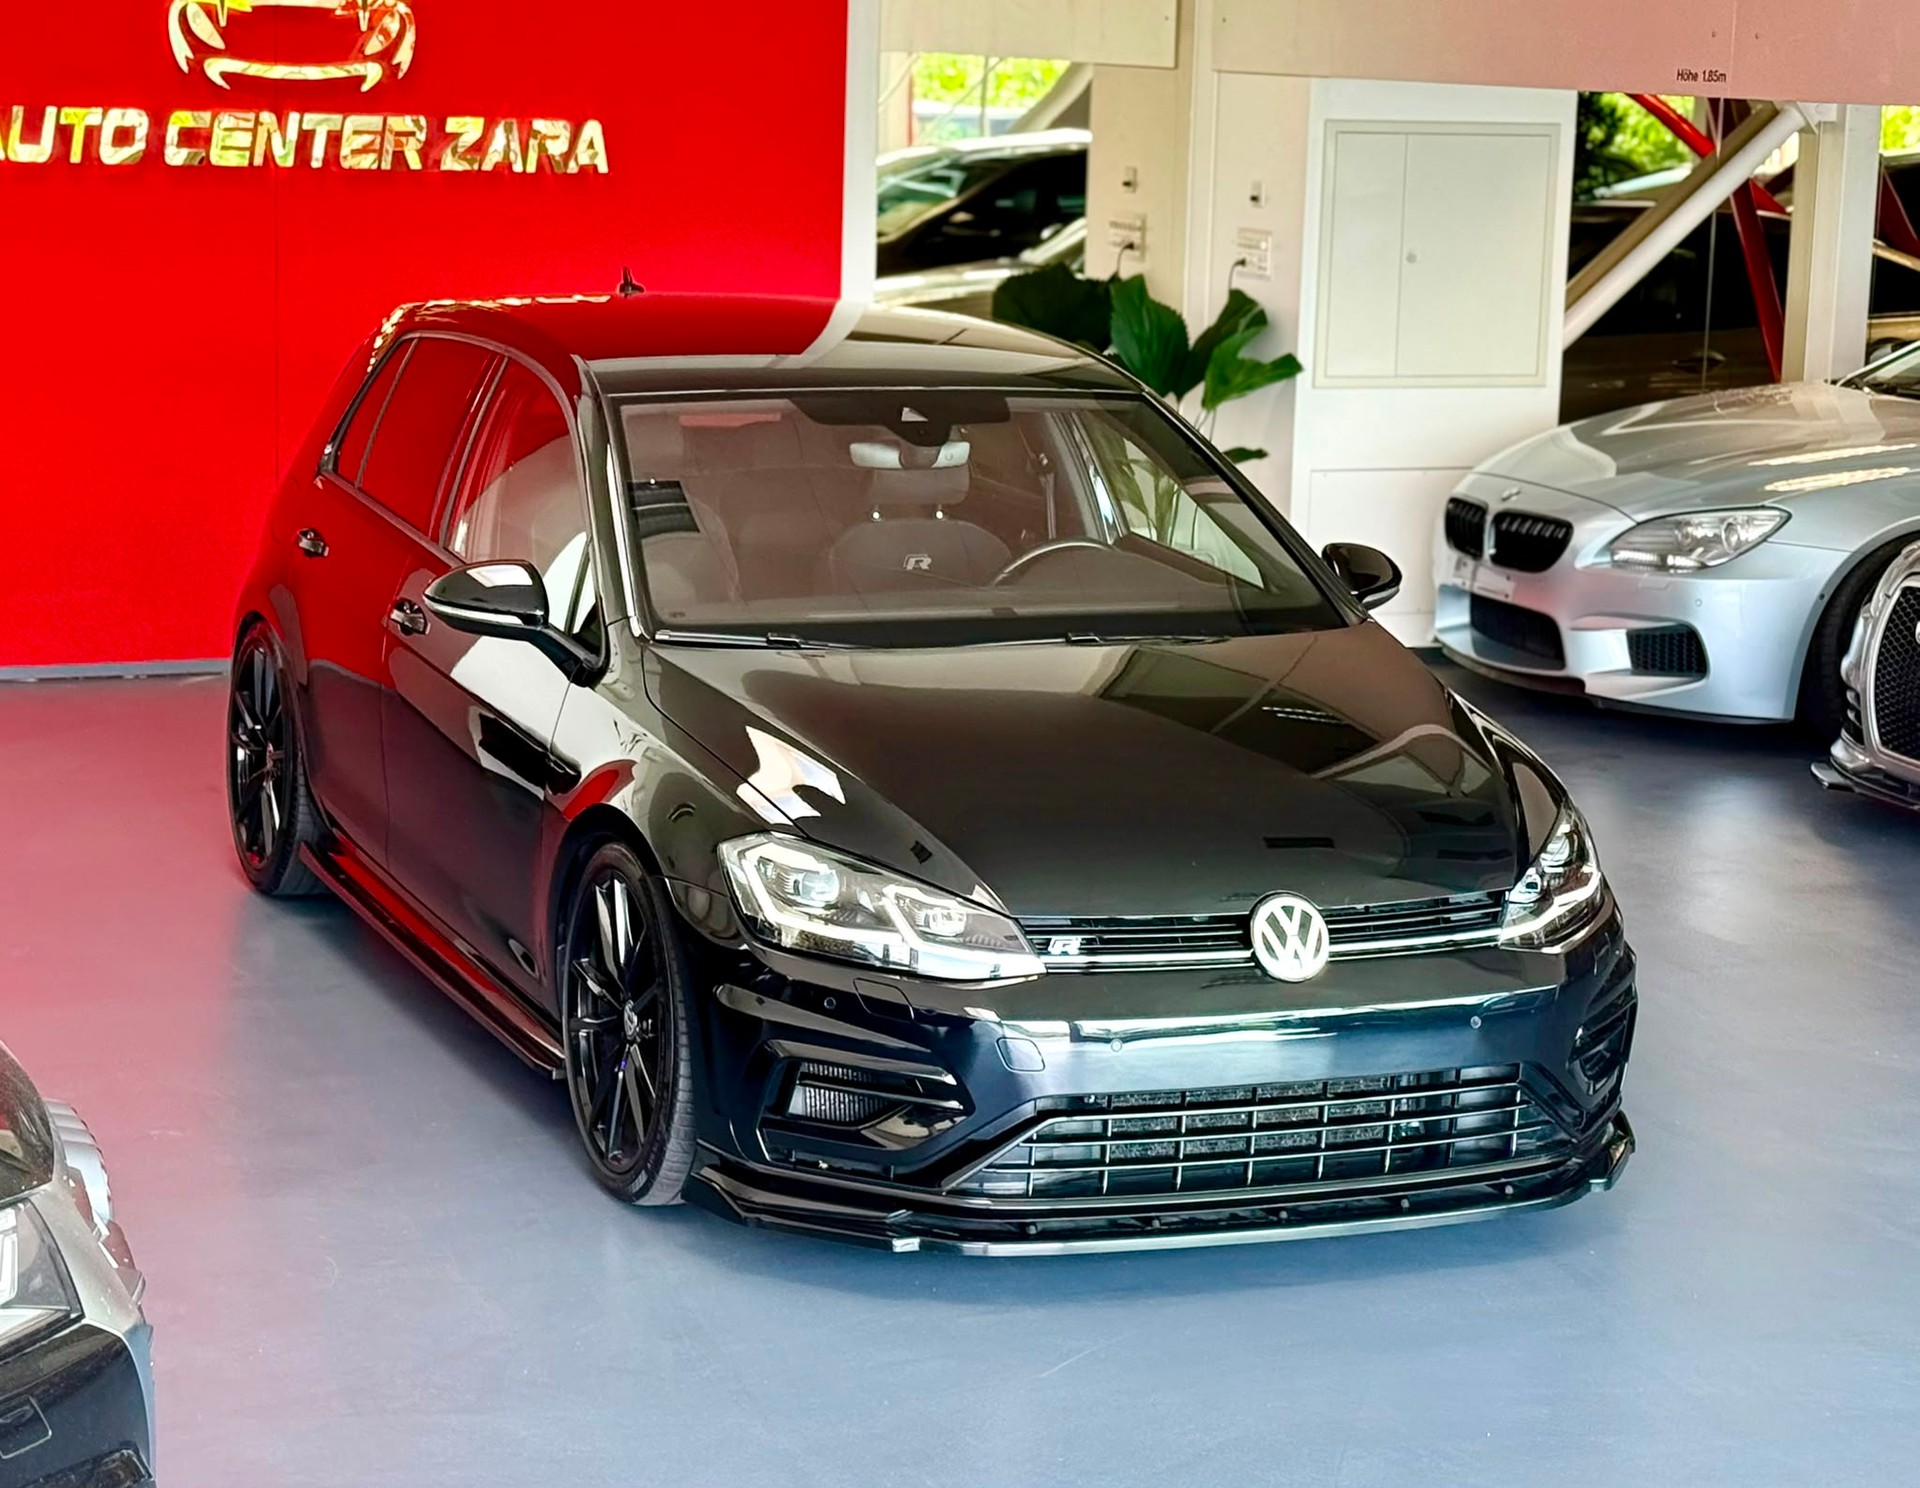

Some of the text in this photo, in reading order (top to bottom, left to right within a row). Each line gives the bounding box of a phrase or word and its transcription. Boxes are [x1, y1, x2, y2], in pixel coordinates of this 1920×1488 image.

[1676, 68, 1699, 82] Höhe
[0, 104, 609, 174] UTO CENTER ZARA
[903, 553, 932, 570] R
